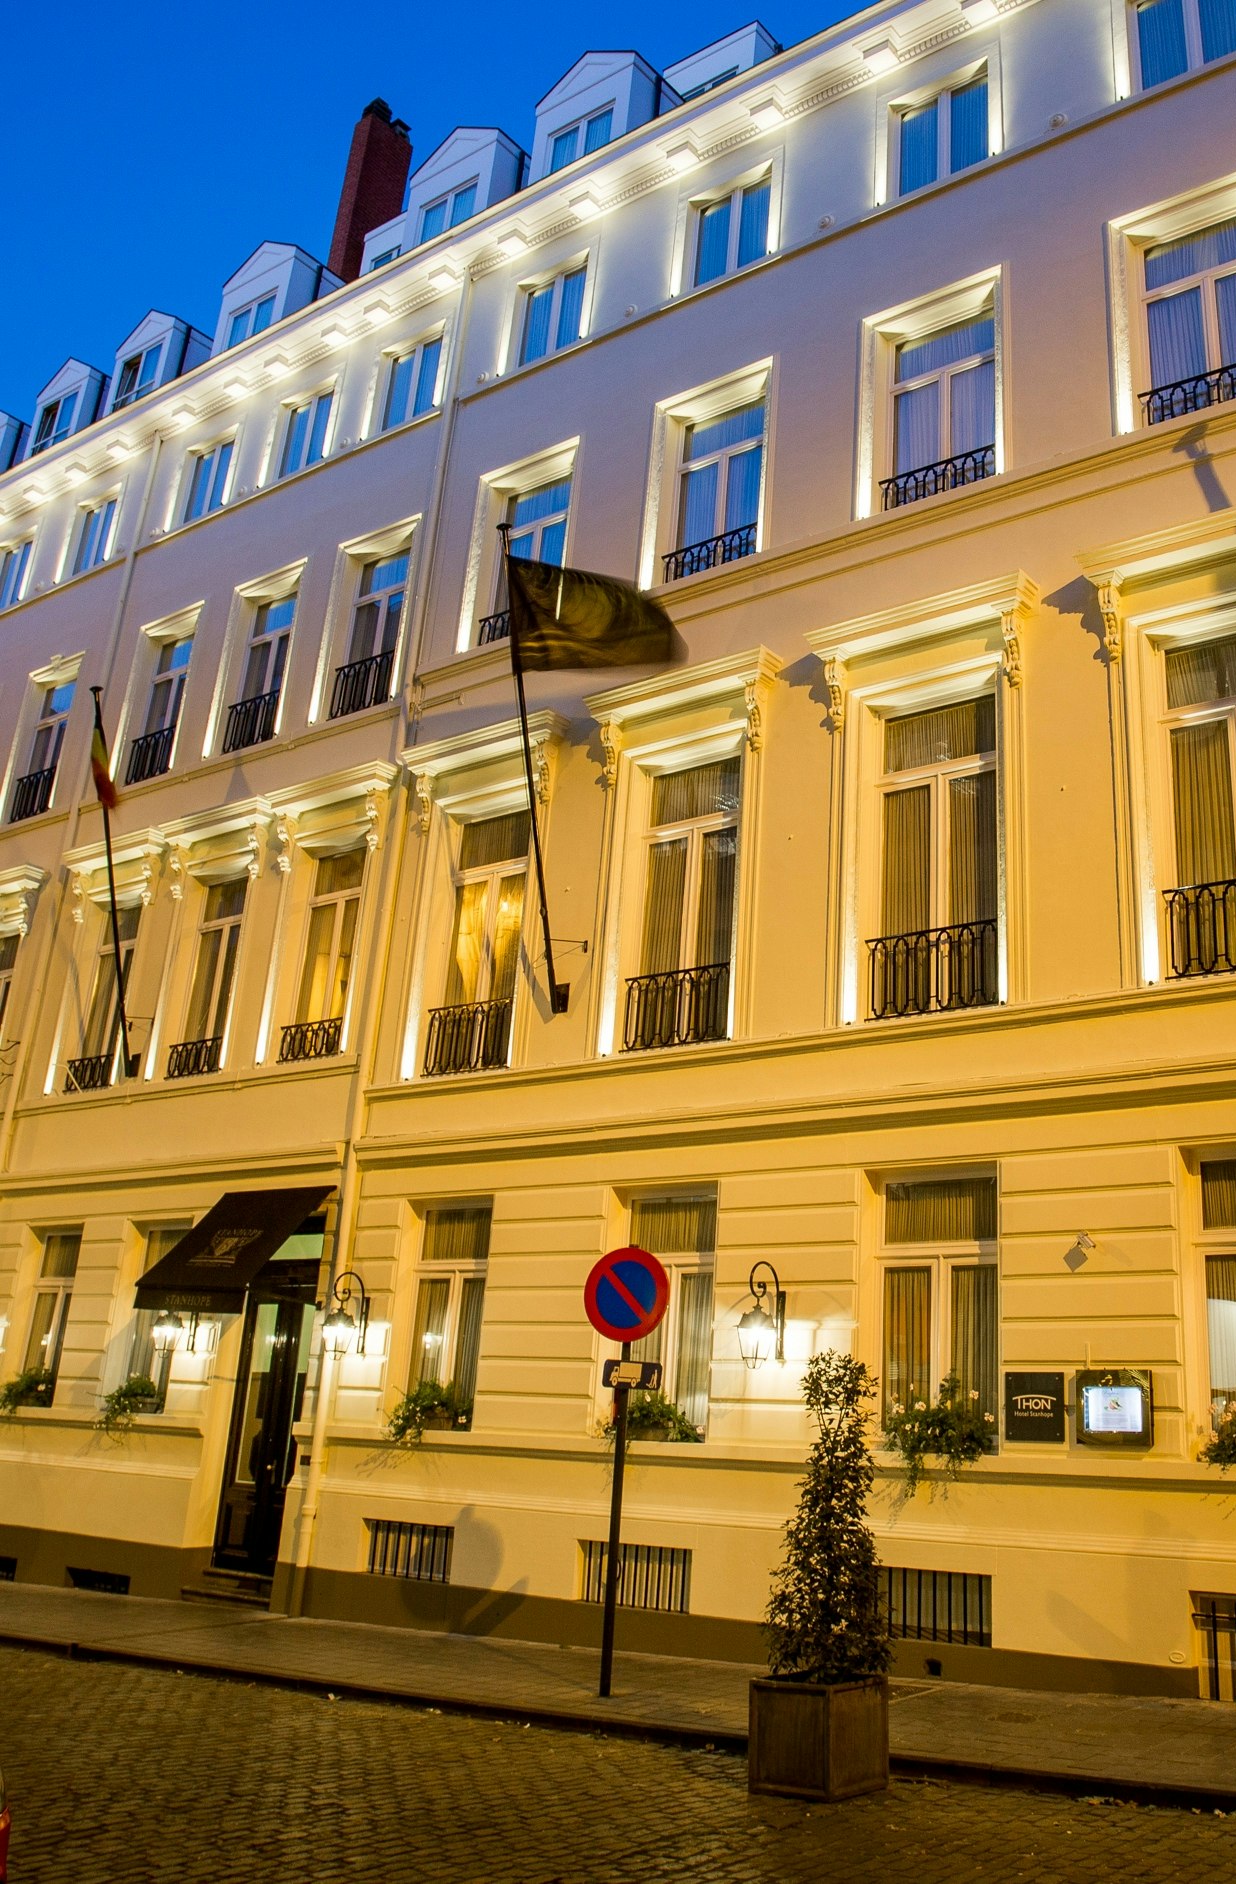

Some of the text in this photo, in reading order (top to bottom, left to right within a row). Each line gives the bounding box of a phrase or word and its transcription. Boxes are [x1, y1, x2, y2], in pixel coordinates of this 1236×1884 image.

[164, 1295, 211, 1307] STANHOPE
[1013, 1394, 1056, 1410] THON
[1030, 1411, 1054, 1419] Stanhope
